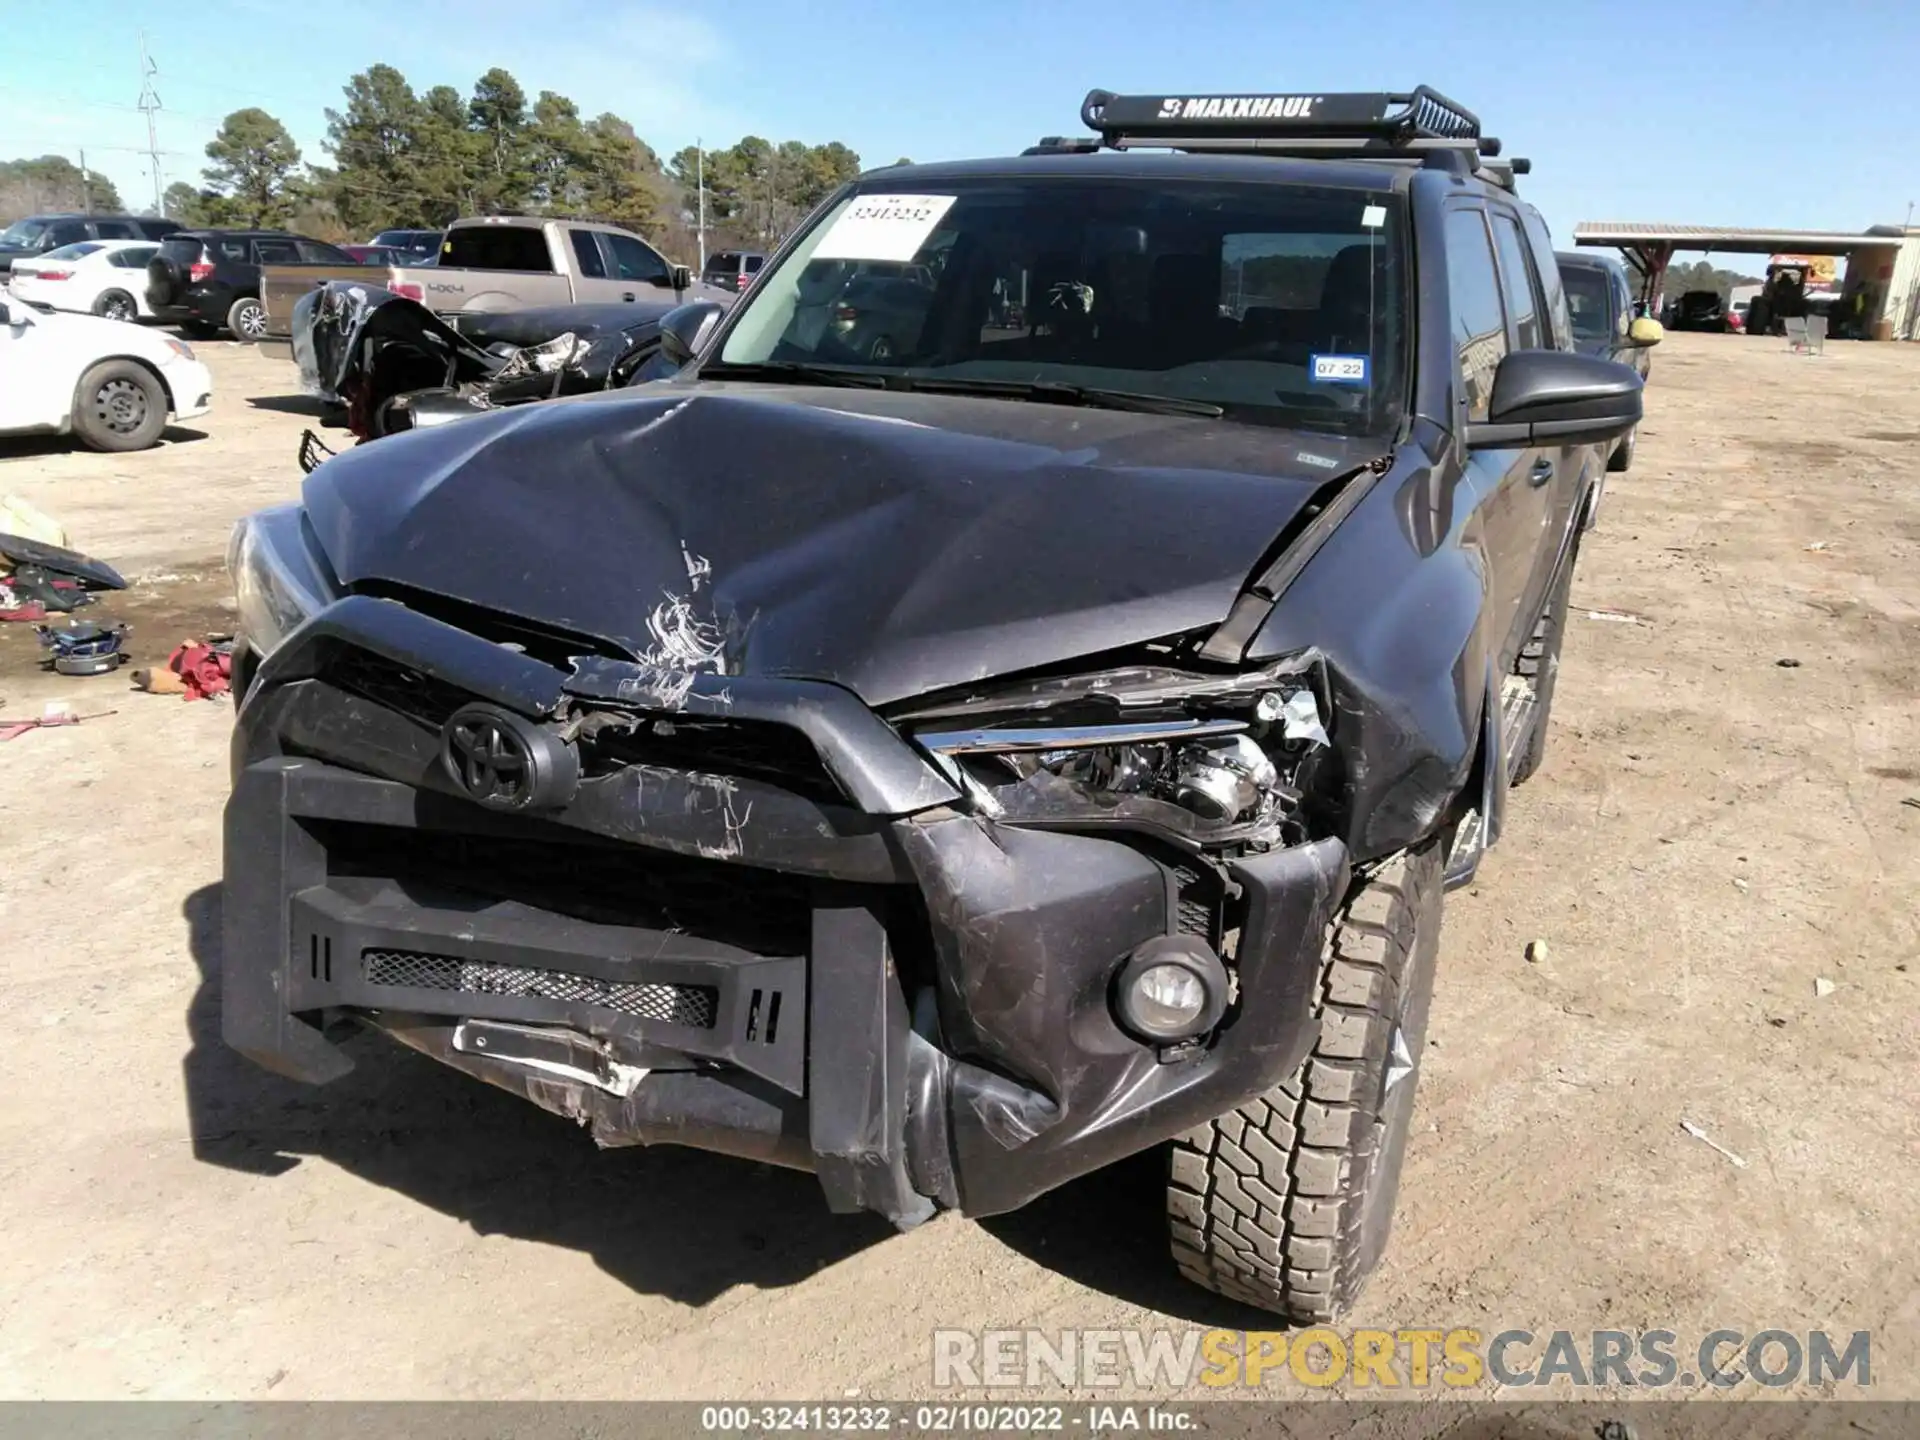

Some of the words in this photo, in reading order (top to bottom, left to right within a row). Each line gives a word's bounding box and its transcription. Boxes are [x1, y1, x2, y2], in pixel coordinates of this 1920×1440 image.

[1182, 97, 1312, 118] MAXXHAUL
[1318, 363, 1336, 374] 07
[1343, 364, 1361, 374] 22
